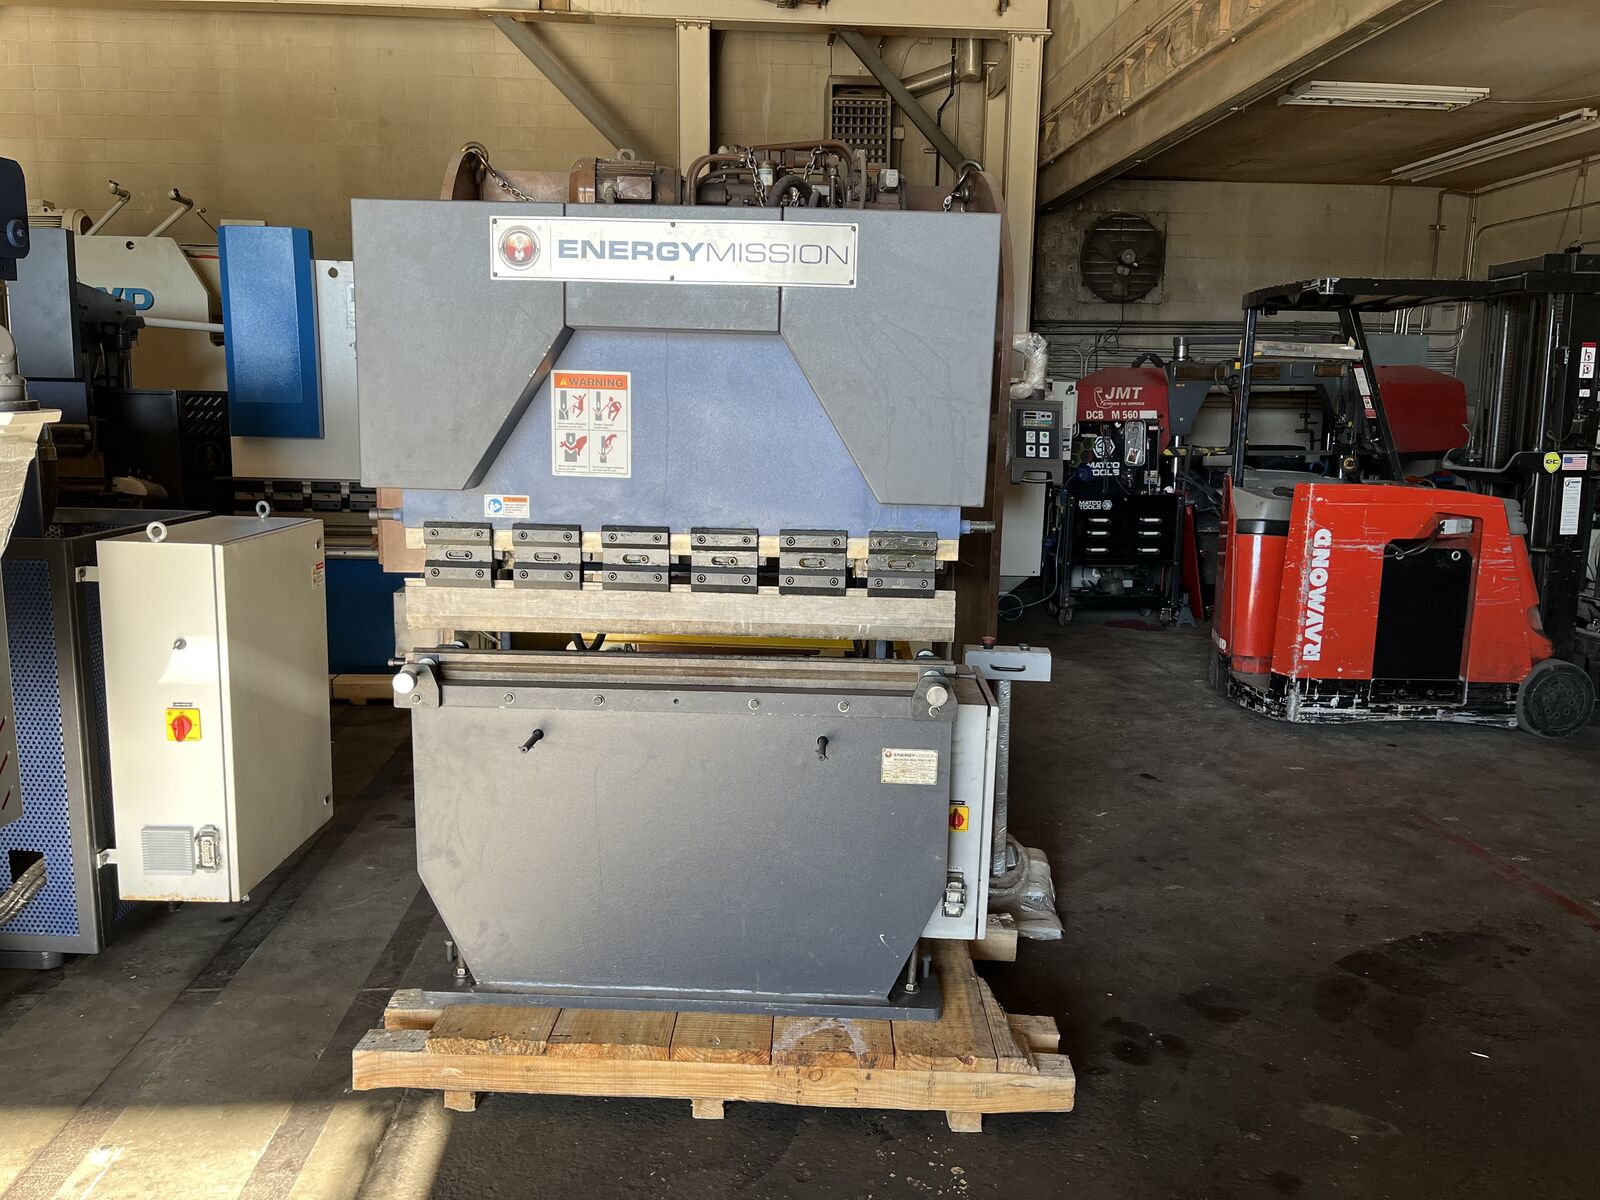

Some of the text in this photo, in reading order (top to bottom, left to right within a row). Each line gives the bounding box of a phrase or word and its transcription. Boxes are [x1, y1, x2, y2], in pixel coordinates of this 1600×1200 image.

[558, 239, 849, 265] ENERGYMISSION
[569, 377, 624, 387] WARNING
[1105, 386, 1143, 400] JMT
[1086, 410, 1138, 420] DCB M 560
[1302, 528, 1332, 661] RAYMOND
